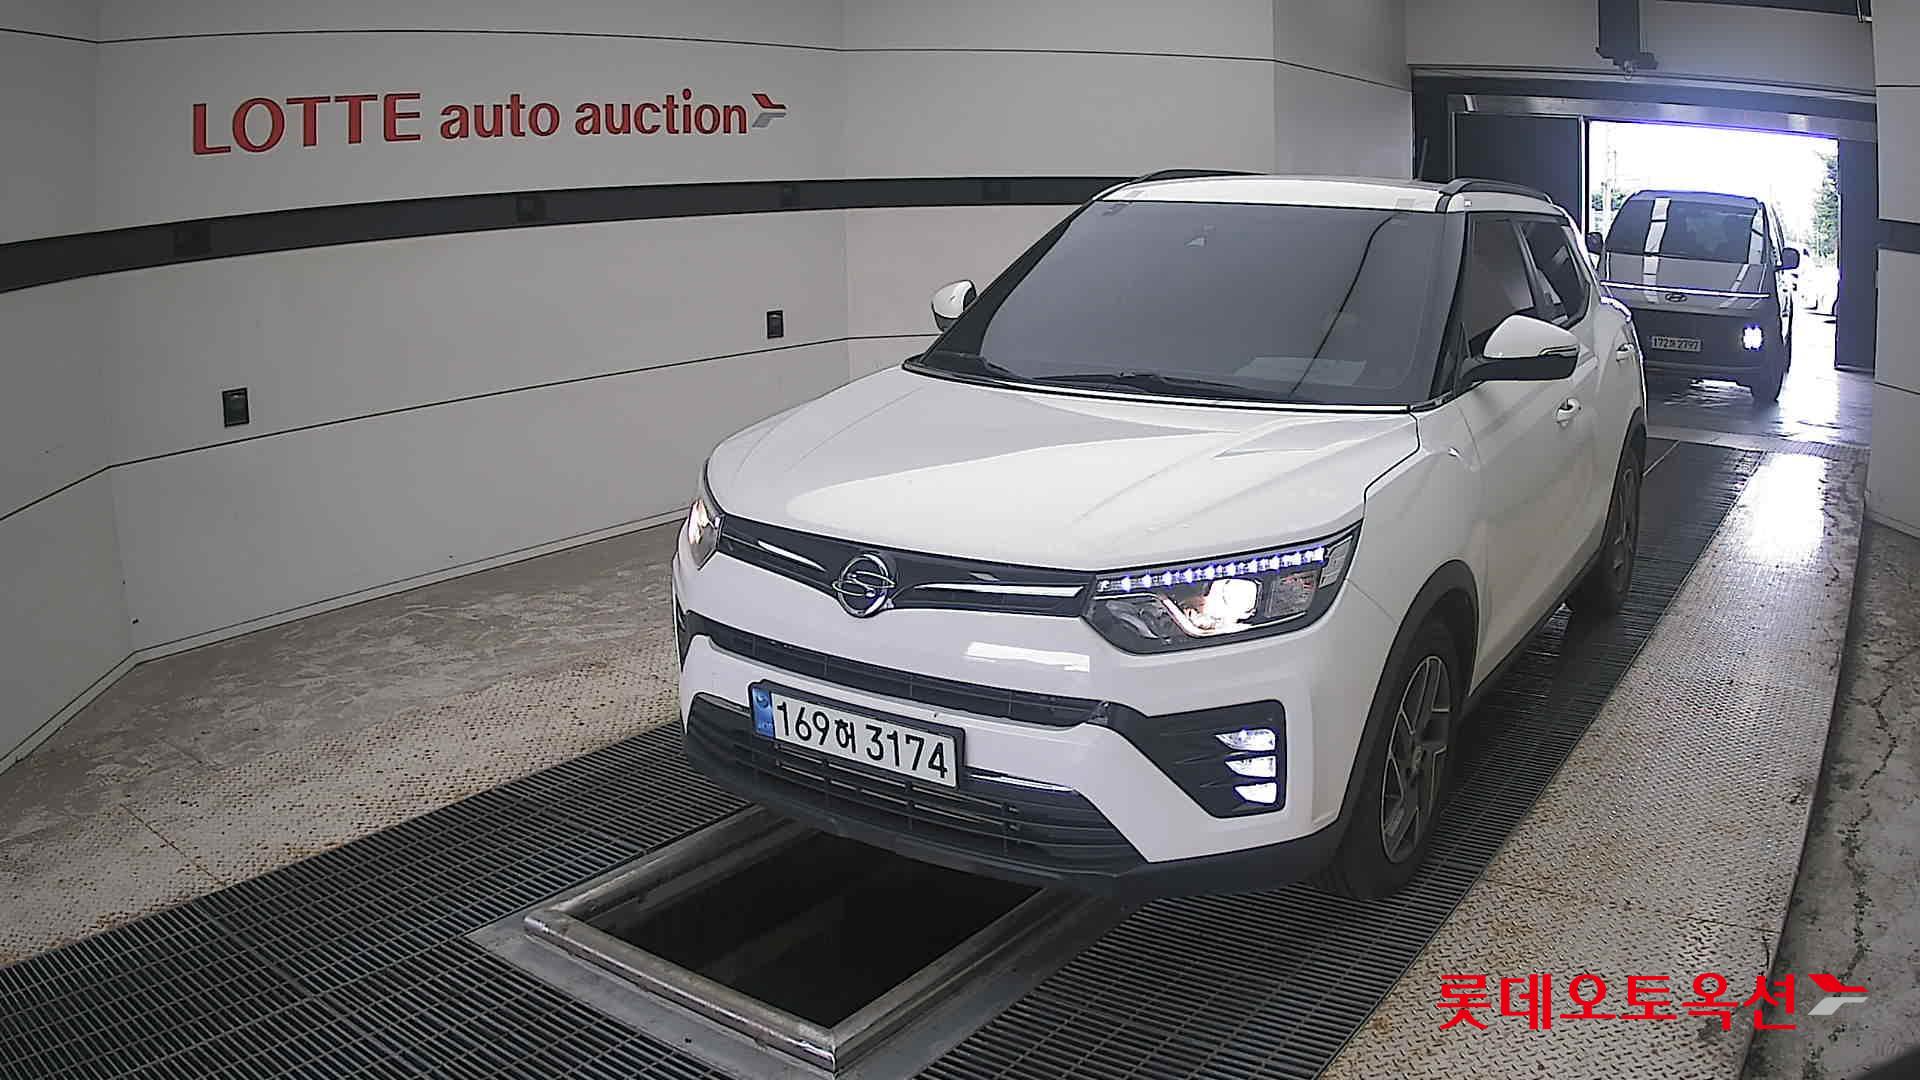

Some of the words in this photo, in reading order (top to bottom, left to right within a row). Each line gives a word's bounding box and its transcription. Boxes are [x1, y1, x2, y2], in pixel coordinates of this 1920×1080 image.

[192, 92, 421, 155] LOTTE
[439, 93, 560, 140] auto
[575, 88, 748, 137] auction
[776, 701, 857, 754] 169허
[865, 724, 949, 779] 3174
